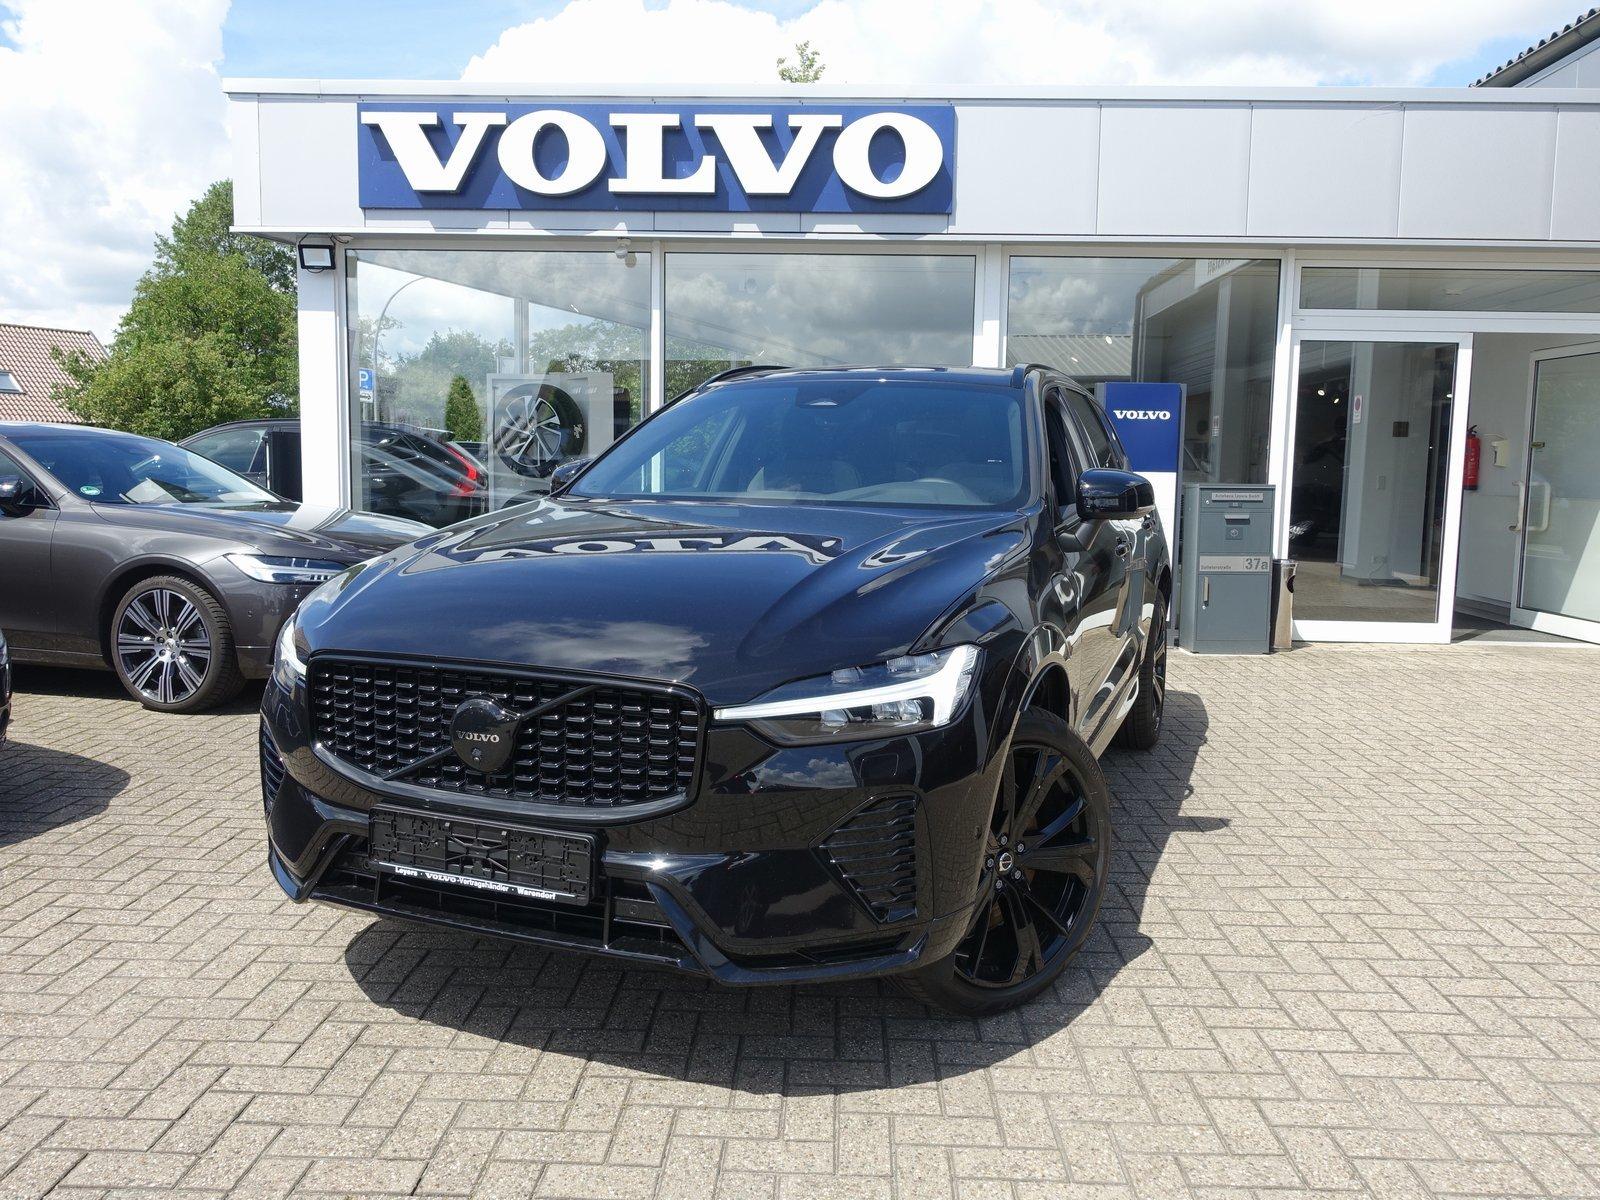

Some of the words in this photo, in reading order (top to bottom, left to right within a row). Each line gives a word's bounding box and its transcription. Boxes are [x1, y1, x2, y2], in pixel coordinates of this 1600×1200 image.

[361, 110, 944, 198] VOLVO
[1113, 410, 1170, 420] VOLVO
[1245, 557, 1269, 570] 37a
[457, 730, 500, 743] VOLVO
